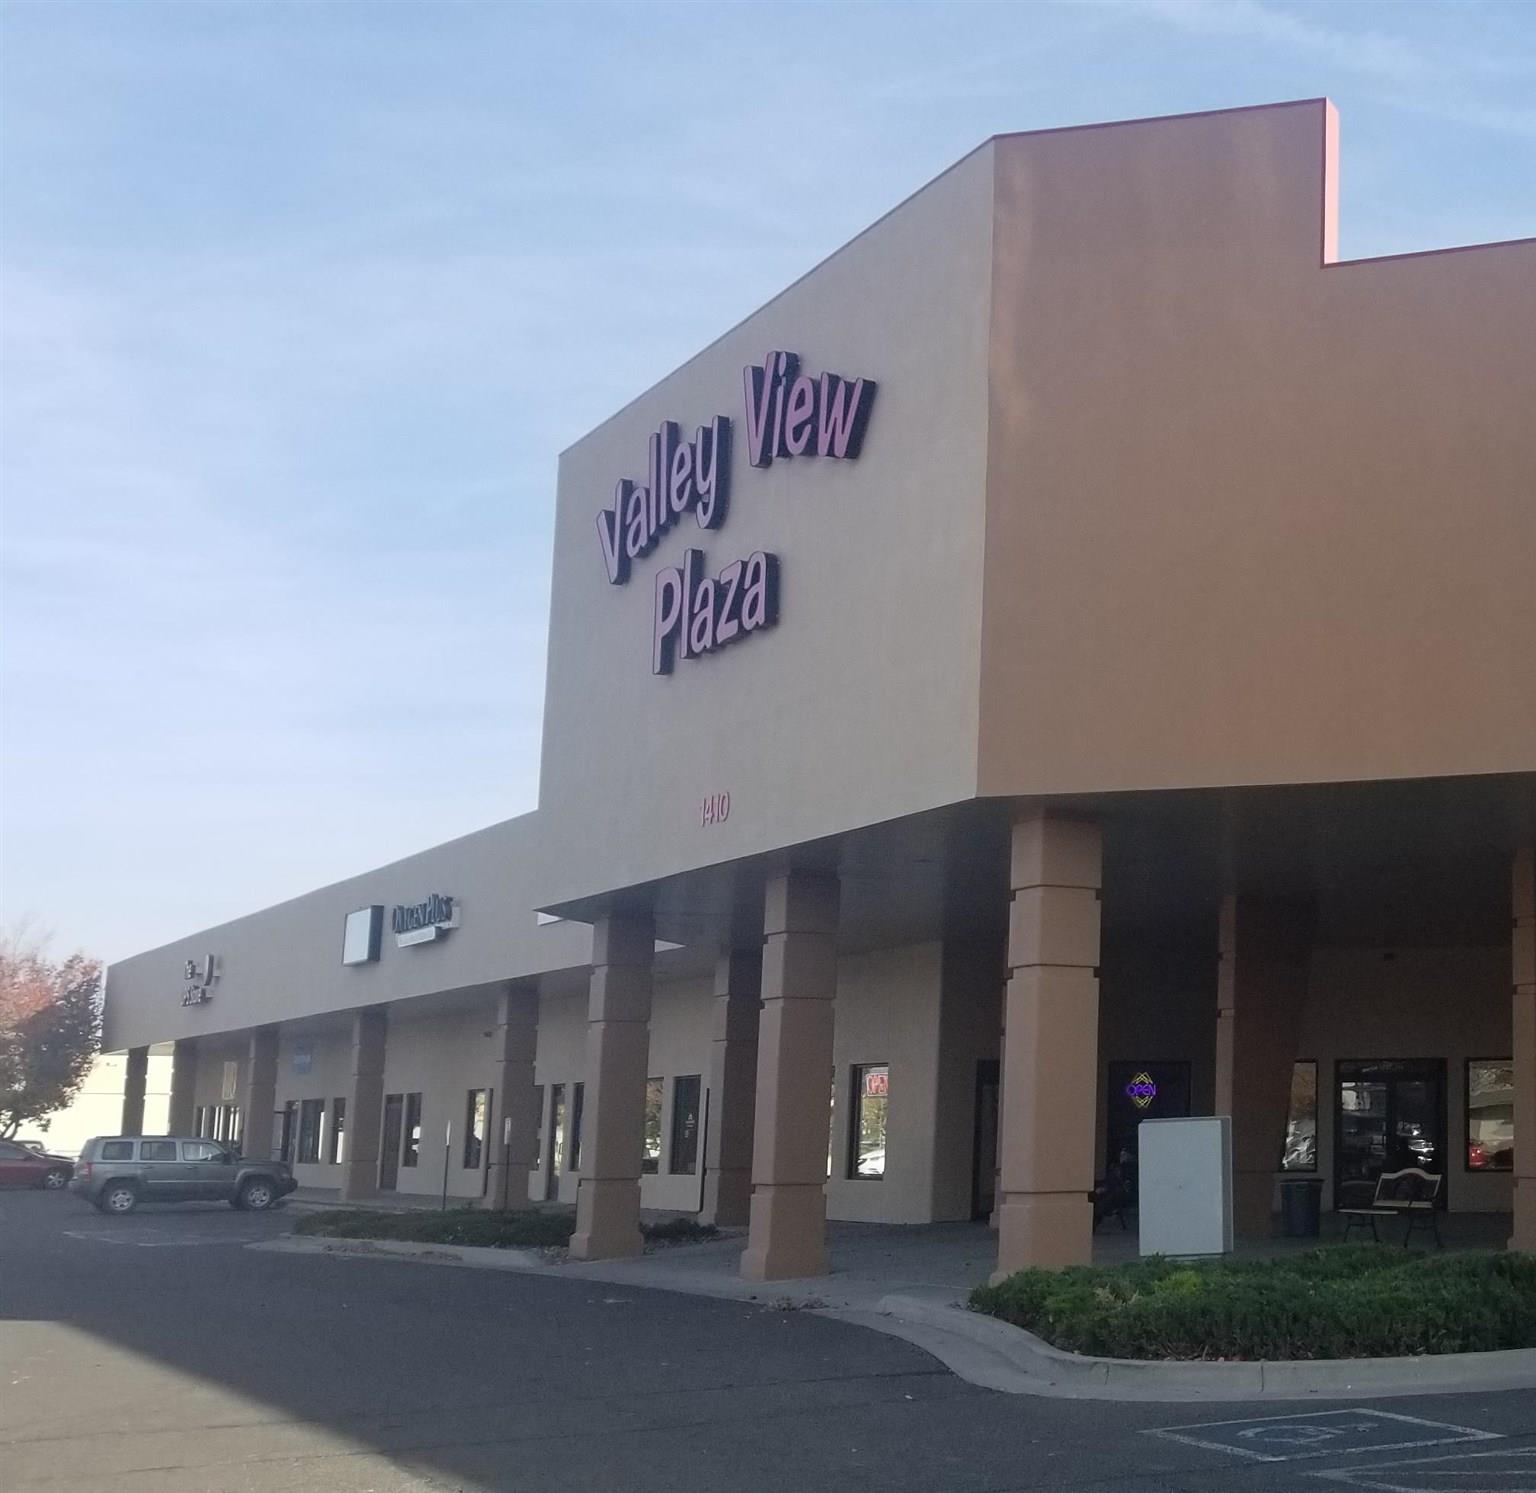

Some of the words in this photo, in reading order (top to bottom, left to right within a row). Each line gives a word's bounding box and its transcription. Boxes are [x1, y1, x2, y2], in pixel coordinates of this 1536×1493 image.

[596, 415, 730, 585] Valley
[743, 351, 876, 467] View
[652, 548, 779, 675] Plaza
[700, 791, 730, 828] 1410
[1126, 1083, 1157, 1097] OPEN
